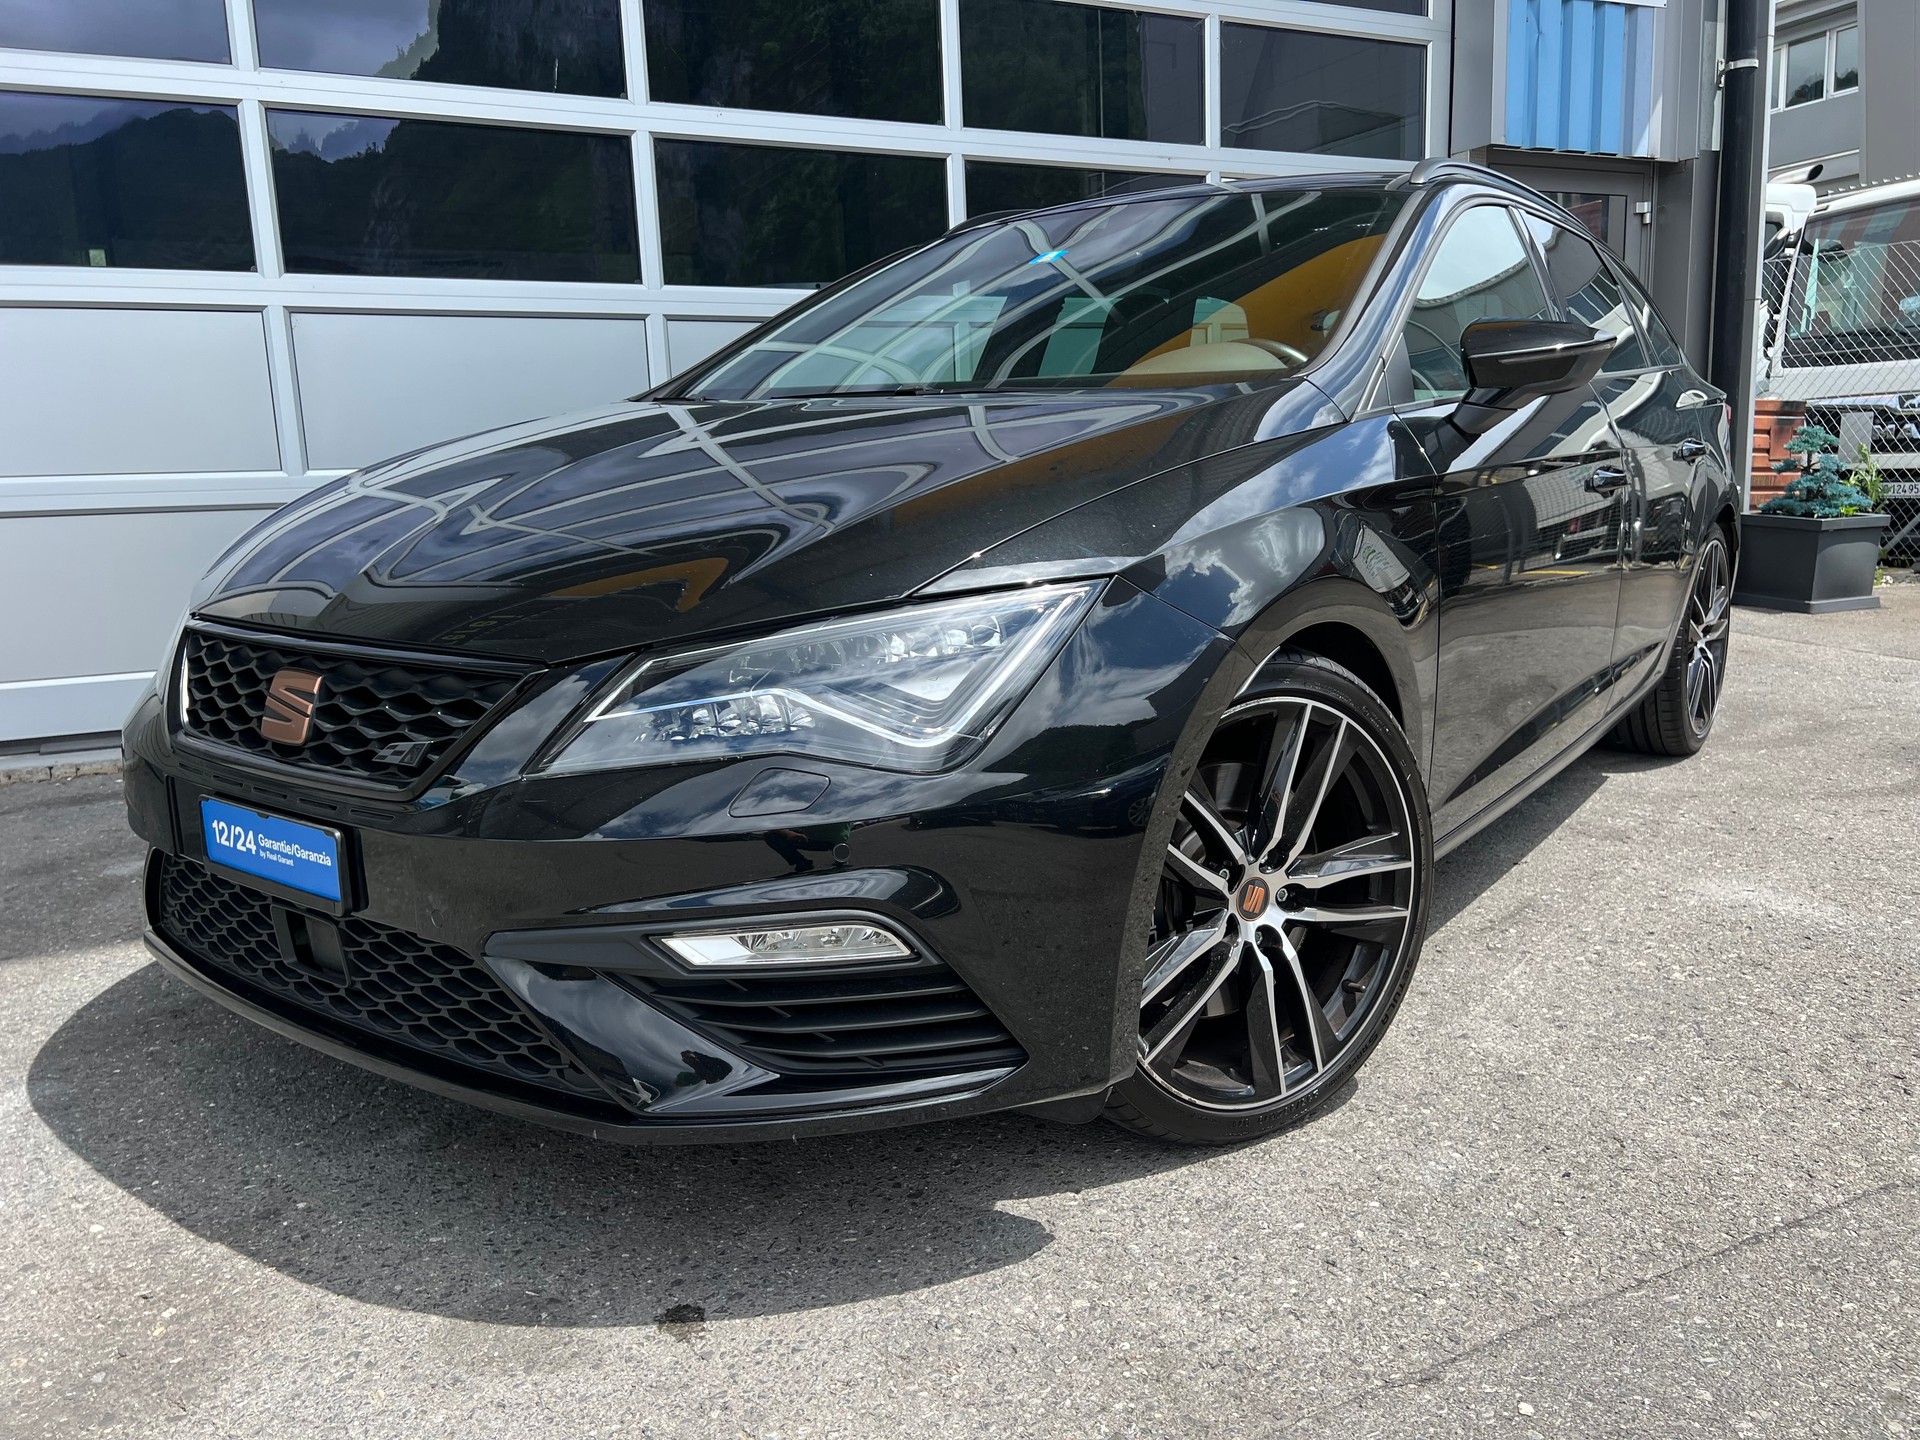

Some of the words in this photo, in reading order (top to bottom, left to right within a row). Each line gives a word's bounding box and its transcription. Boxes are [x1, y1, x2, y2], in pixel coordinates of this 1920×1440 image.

[212, 819, 257, 855] 12/24
[258, 834, 332, 867] Garantie/Garanzia
[259, 849, 266, 859] by
[277, 855, 294, 867] Garant
